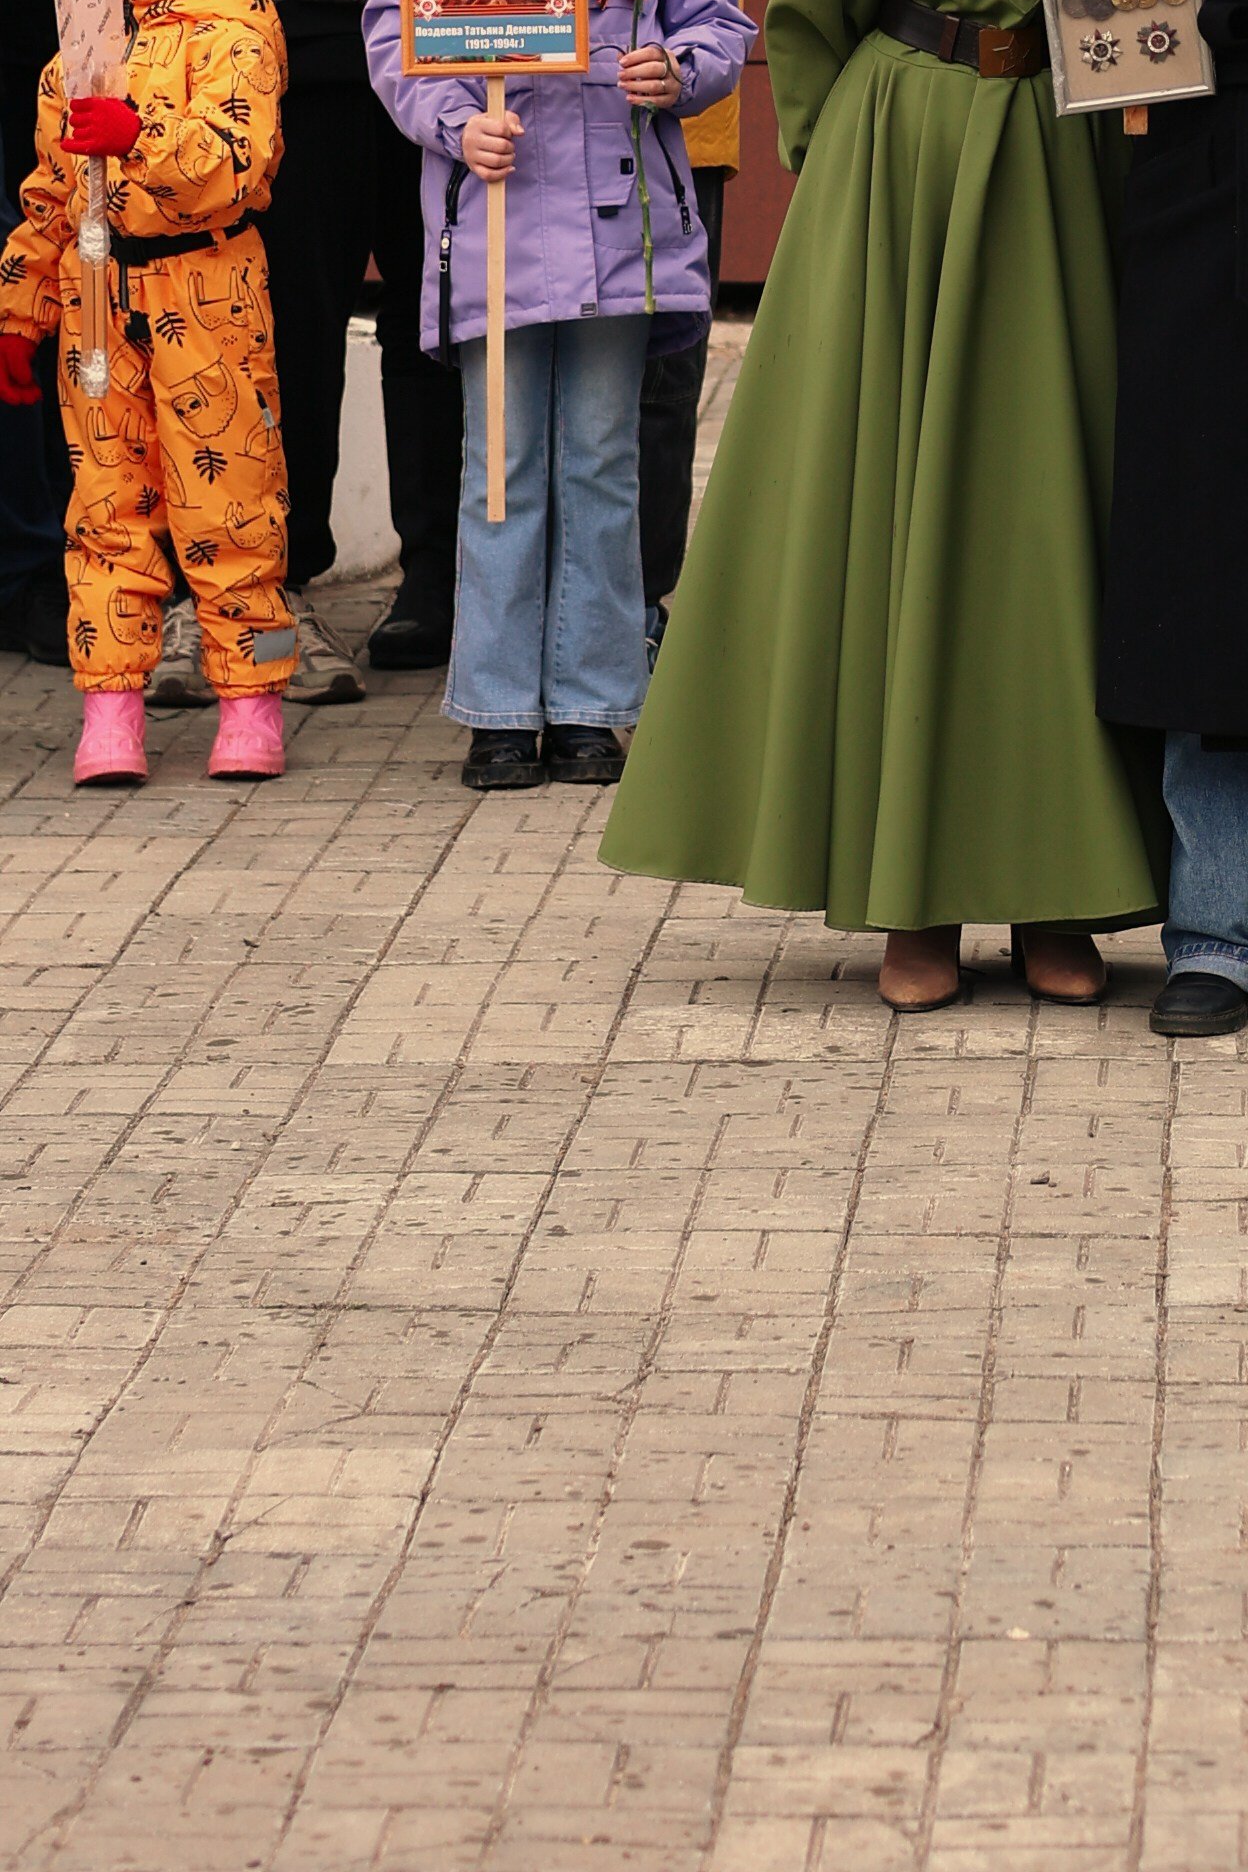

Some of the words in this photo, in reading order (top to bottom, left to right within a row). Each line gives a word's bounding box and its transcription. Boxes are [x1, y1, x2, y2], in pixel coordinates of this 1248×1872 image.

[415, 26, 463, 38] Поздеева
[464, 25, 504, 36] Татьяна
[505, 24, 573, 36] Дементьевна
